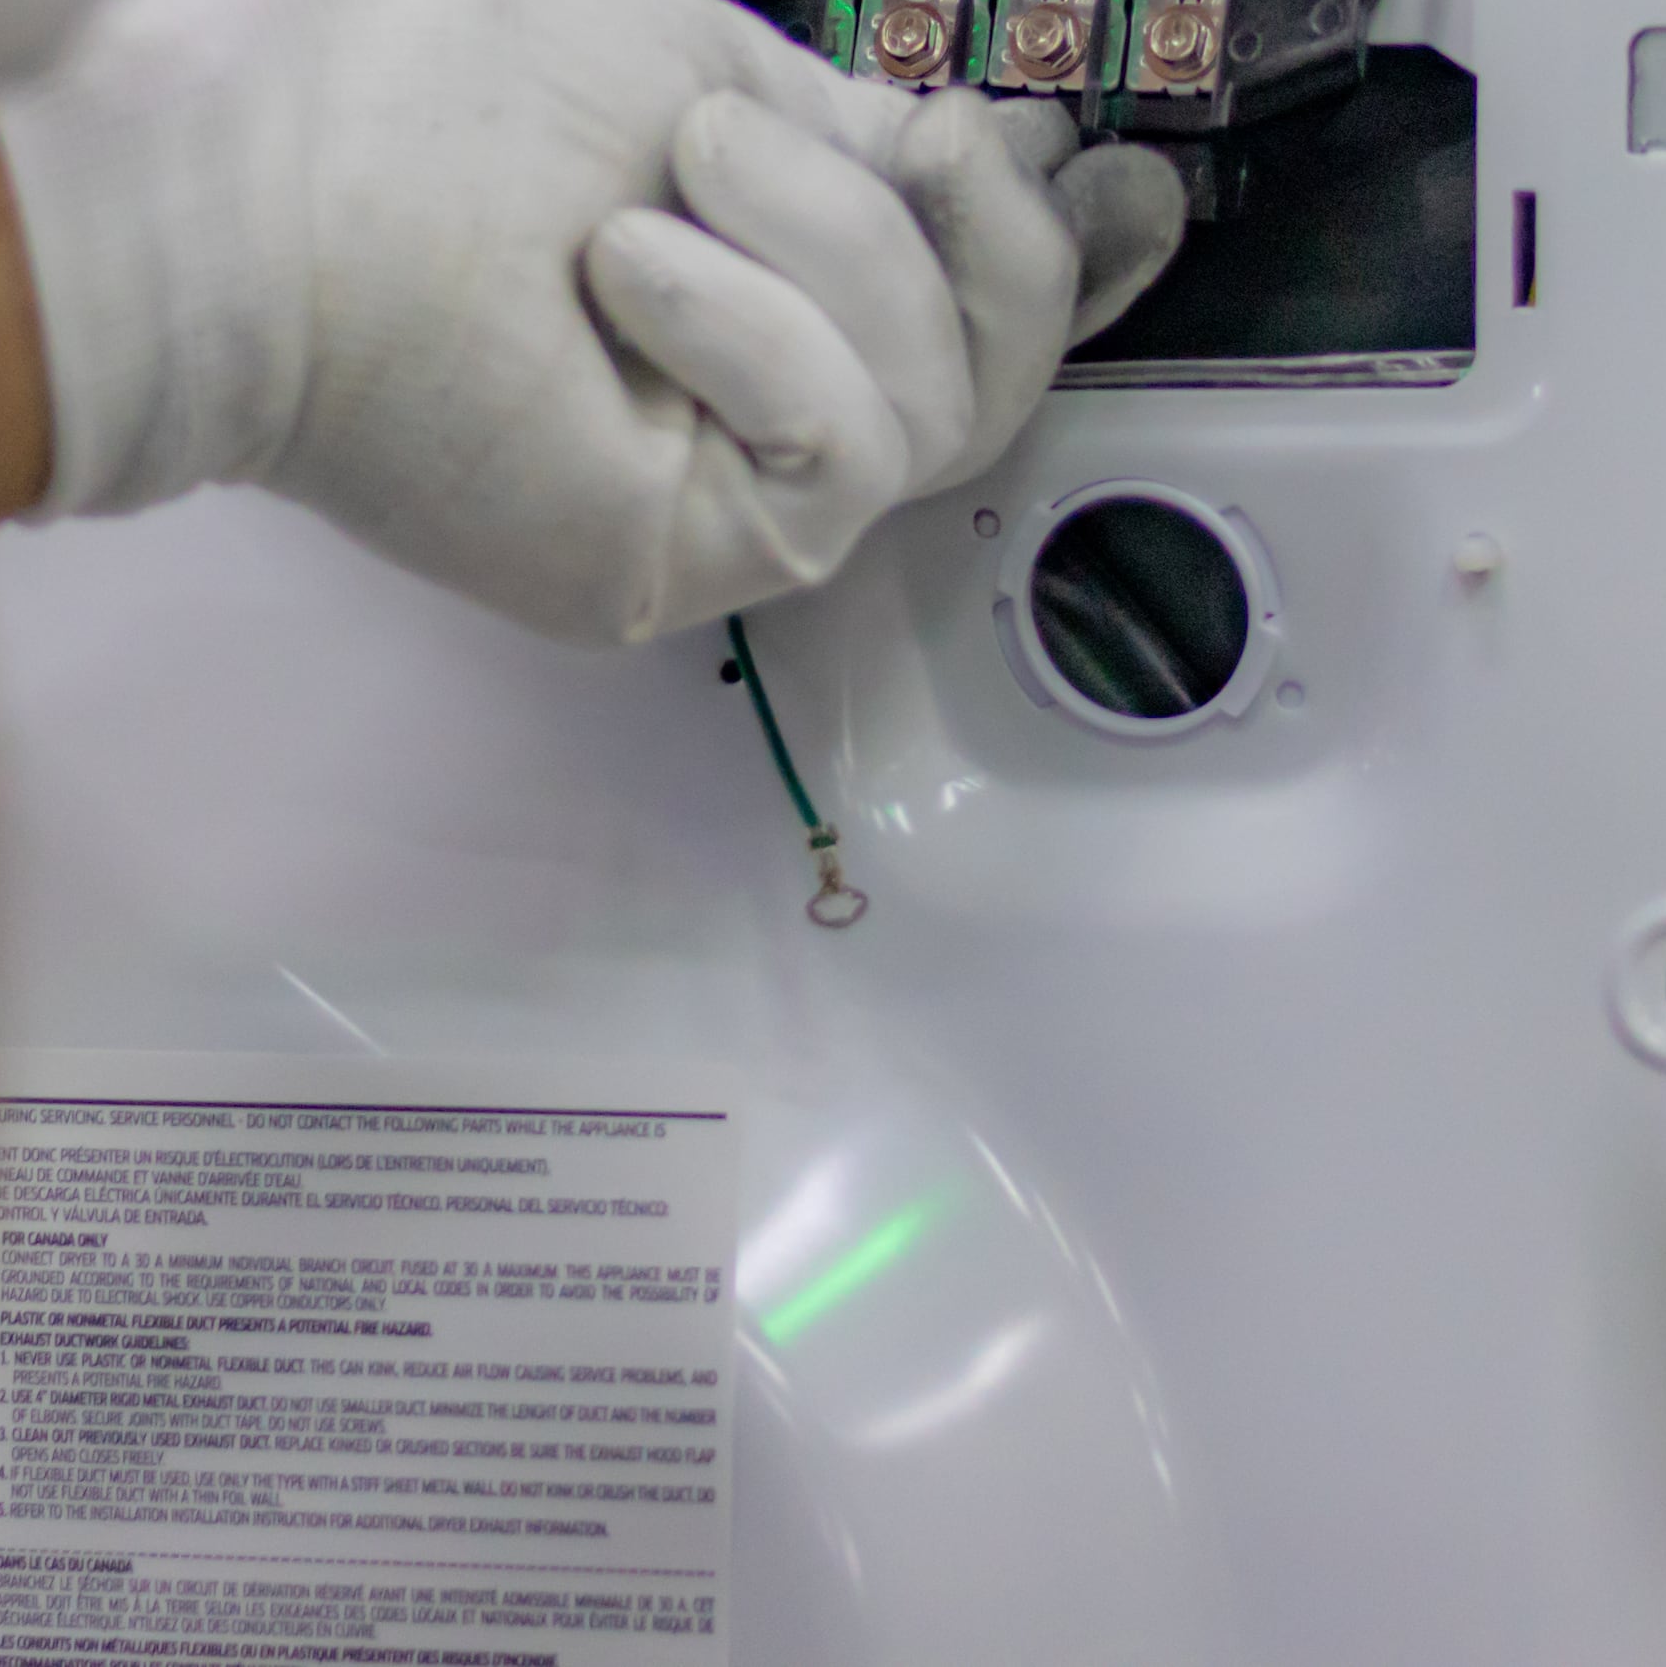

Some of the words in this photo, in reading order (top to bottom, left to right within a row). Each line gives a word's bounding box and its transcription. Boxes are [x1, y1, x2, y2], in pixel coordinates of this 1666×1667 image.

[109, 1111, 158, 1126] SERVICE
[162, 1113, 232, 1127] PERSONNEL
[246, 1114, 265, 1128] DO
[267, 1115, 292, 1129] NOT
[21, 1148, 54, 1164] DONC
[60, 1149, 130, 1165] PRÉSENTER
[133, 1150, 152, 1166] UN
[155, 1151, 199, 1167] RISQUE
[202, 1151, 314, 1169] D'ÉLECTROCUTION
[36, 1169, 52, 1182] DE
[56, 1170, 128, 1184] COMMANDE
[133, 1171, 146, 1184] ET
[151, 1171, 193, 1185] VANNE
[197, 1172, 259, 1186] D'ARRIVÉE
[13, 1187, 79, 1202] DESCARGA
[83, 1189, 150, 1204] ELÉCTRICA
[153, 1190, 237, 1206] ÚNICAMENTE
[241, 1192, 302, 1207] DURANTE
[305, 1193, 319, 1208] EL
[62, 1208, 120, 1223] VÁLVULA
[123, 1209, 140, 1224] DE
[1, 1231, 25, 1245] FOR
[27, 1231, 74, 1246] CANADA
[77, 1232, 109, 1247] ONLY
[1, 1251, 52, 1265] CONNECT
[58, 1252, 96, 1266] DRYER
[102, 1253, 116, 1267] TO
[168, 1255, 223, 1270] MINIMUM
[0, 1270, 64, 1285] GROUNDED
[70, 1272, 133, 1287] ACCORDING
[139, 1273, 154, 1287] TO
[160, 1274, 180, 1288] THE
[0, 1289, 47, 1303] HAZARD
[50, 1290, 73, 1304] DUE
[78, 1290, 91, 1304] TO
[94, 1291, 157, 1306] ELECTRICAL
[205, 1293, 227, 1307] USE
[0, 1311, 43, 1326] PLASTIC
[47, 1312, 64, 1327] OR
[66, 1313, 126, 1328] NONMETAL
[131, 1314, 183, 1330] FLEXIBLE
[186, 1316, 215, 1330] DUCT
[218, 1317, 275, 1332] PRESENTS
[0, 1332, 50, 1347] EXHAUST
[54, 1333, 118, 1348] DUCTWORK
[13, 1353, 51, 1366] NEVER
[55, 1354, 77, 1367] USE
[81, 1355, 123, 1368] PLASTIC
[129, 1356, 146, 1369] OR
[150, 1357, 210, 1371] NONMETAL
[11, 1370, 68, 1385] PRESENTS
[82, 1372, 141, 1387] POTENTIAL
[146, 1373, 170, 1388] FIRE
[11, 1390, 32, 1404] USE
[49, 1391, 107, 1406] DIAMETER
[109, 1393, 140, 1407] RIGID
[142, 1394, 177, 1408] METAL
[11, 1409, 25, 1423] OF
[81, 1411, 123, 1426] SECURE
[128, 1412, 165, 1427] JOINTS
[169, 1413, 199, 1428] WITH
[11, 1428, 48, 1443] CLEAN
[51, 1429, 73, 1443] OUT
[78, 1430, 146, 1446] PREVIOUSLY
[150, 1432, 180, 1447] USED
[9, 1446, 48, 1462] OPENS
[51, 1447, 76, 1462] AND
[78, 1448, 119, 1463] CLOSES
[22, 1467, 73, 1482] FLEXIBLE
[76, 1468, 105, 1483] DUCT
[108, 1469, 139, 1485] MUST
[142, 1470, 156, 1485] BE
[194, 1472, 215, 1487] USE
[9, 1484, 32, 1500] NOT
[36, 1485, 57, 1500] USE
[61, 1486, 111, 1502] FLEXIBLE
[115, 1487, 144, 1502] DUCT
[148, 1489, 178, 1503] WITH
[193, 1490, 219, 1504] THIN
[221, 1491, 244, 1505] FOIL
[9, 1503, 45, 1518] REFER
[48, 1505, 62, 1518] TO
[66, 1505, 86, 1519] THE
[89, 1506, 168, 1522] INSTALLATION
[28, 1557, 41, 1569] LE
[44, 1557, 65, 1570] CAS
[67, 1558, 84, 1571] DU
[86, 1558, 133, 1572] CANADA
